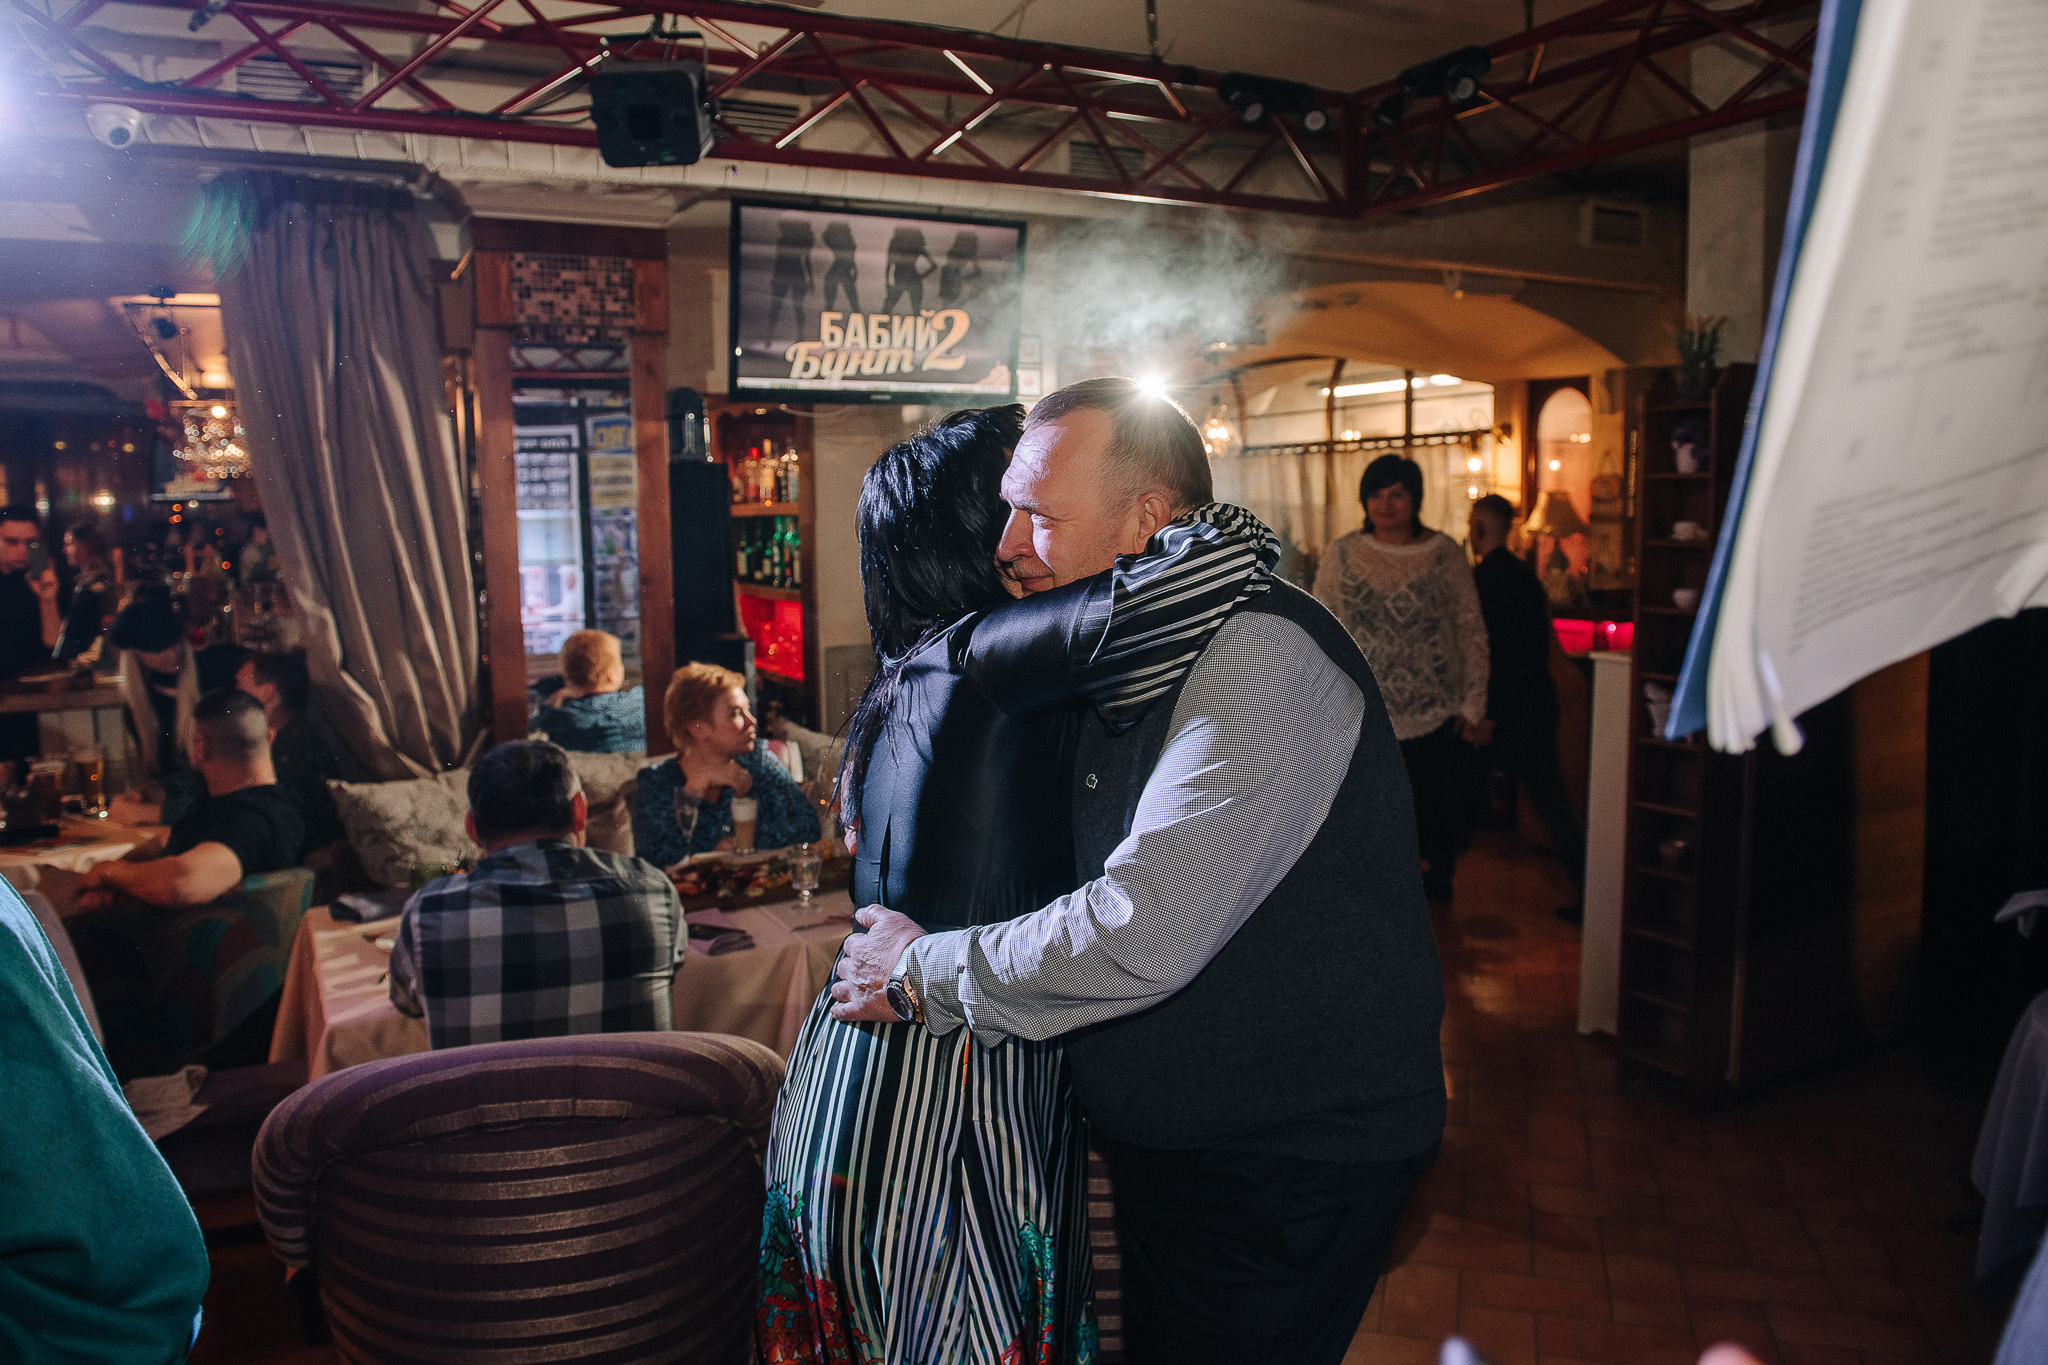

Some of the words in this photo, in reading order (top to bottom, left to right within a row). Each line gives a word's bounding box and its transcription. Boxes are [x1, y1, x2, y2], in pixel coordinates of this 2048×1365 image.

[785, 341, 914, 380] Бунт
[820, 309, 938, 351] БАБИЙ
[922, 308, 971, 371] 2
